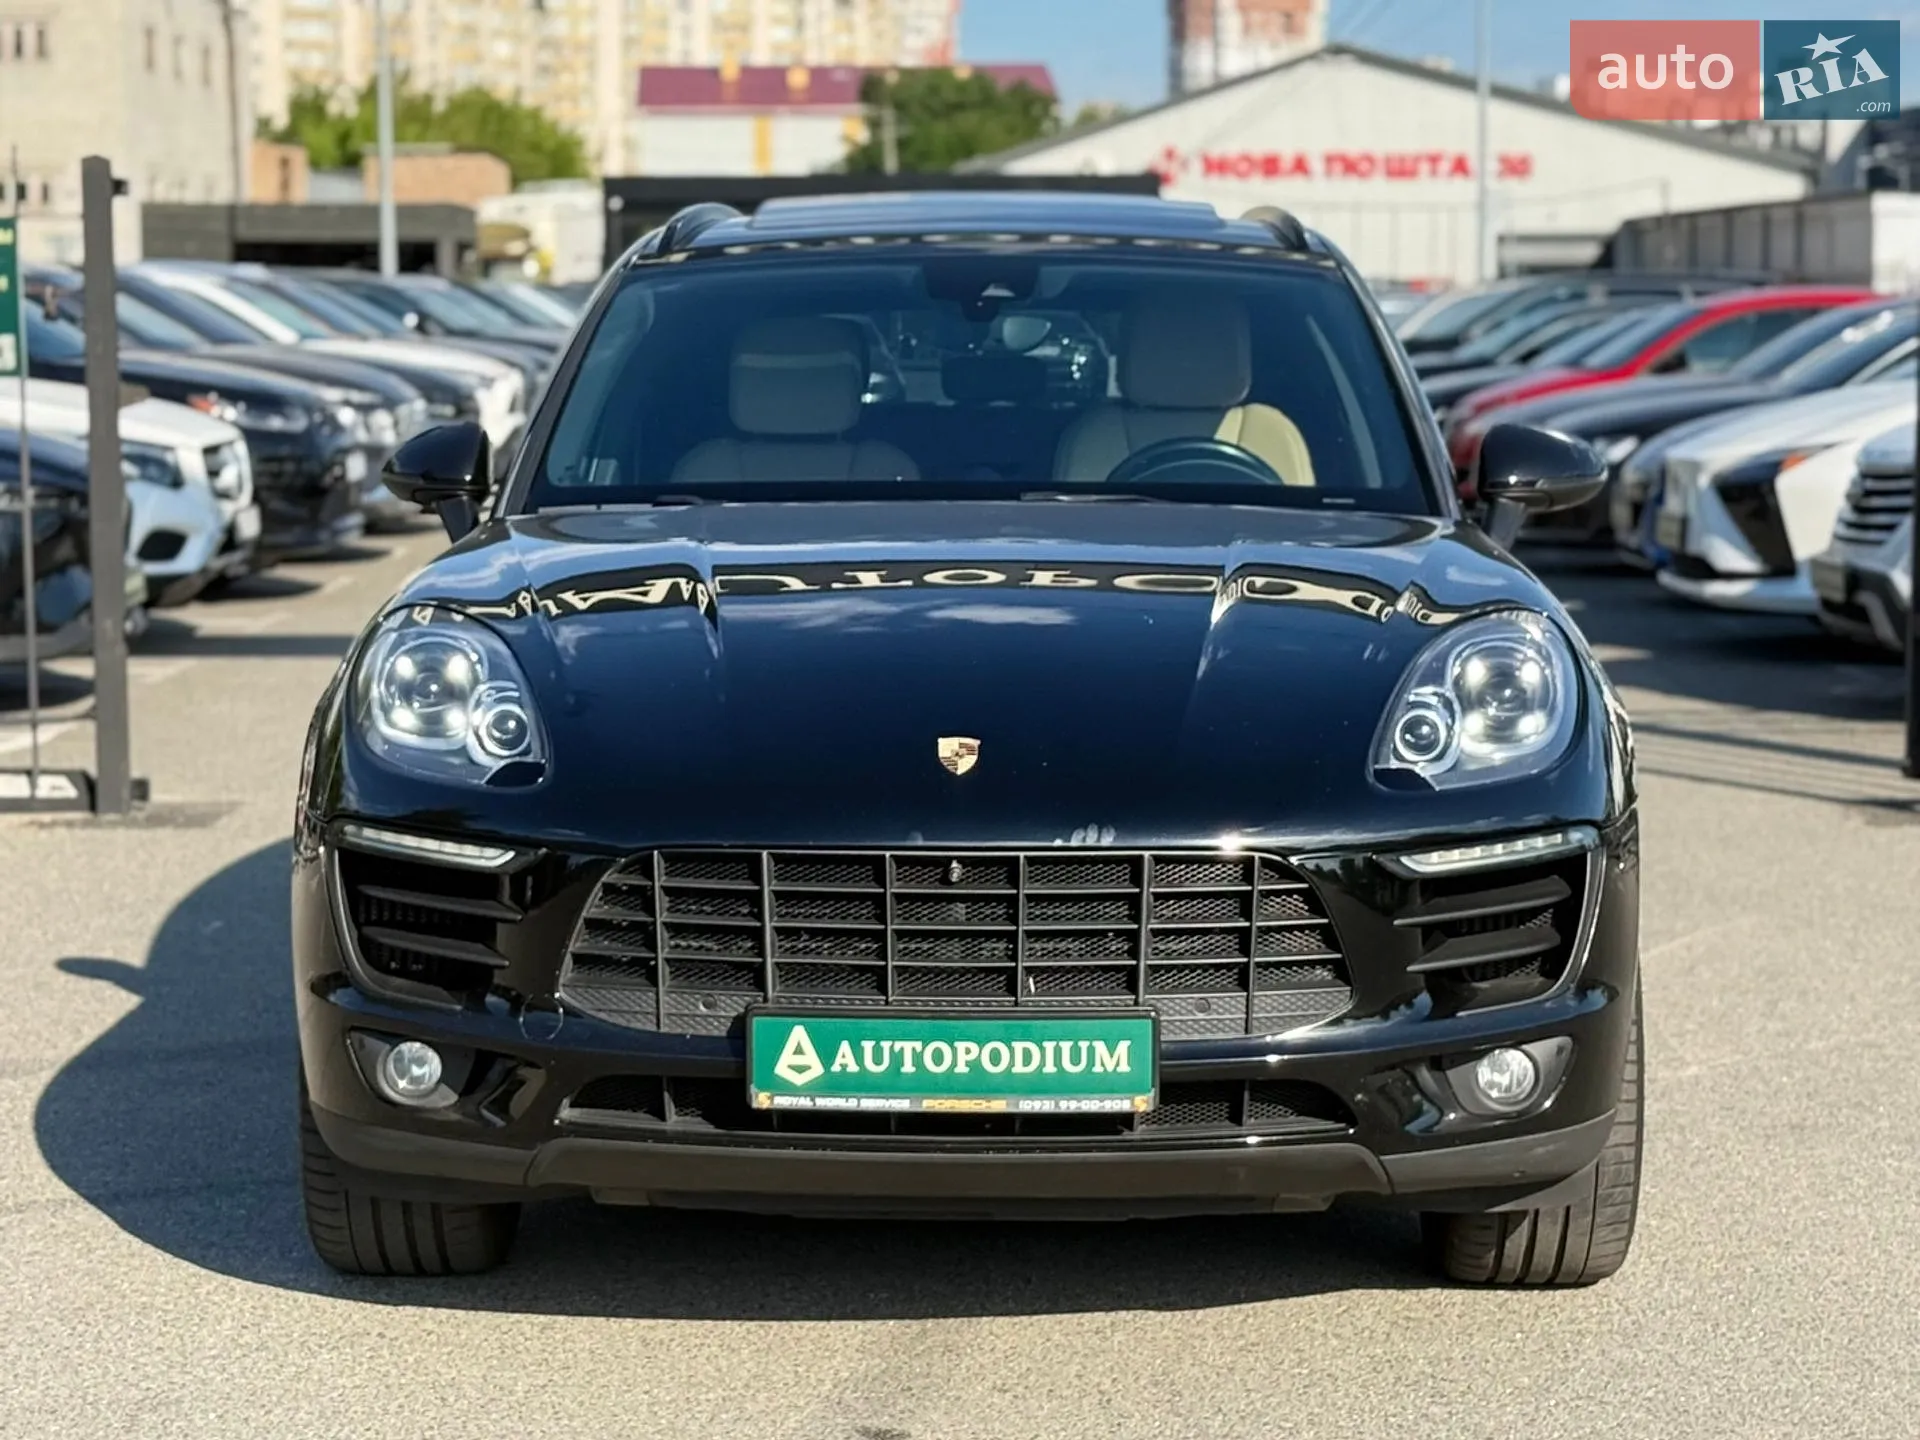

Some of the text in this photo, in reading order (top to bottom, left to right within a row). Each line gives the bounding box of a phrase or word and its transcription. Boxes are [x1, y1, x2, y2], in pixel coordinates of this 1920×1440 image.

[1201, 154, 1311, 179] НОВА
[1323, 153, 1471, 179] ПОШТА
[830, 1040, 1132, 1073] AUTOPODIUM
[773, 1096, 813, 1107] ROYAL
[815, 1097, 857, 1108] WORLD
[860, 1098, 910, 1109] SERVICE
